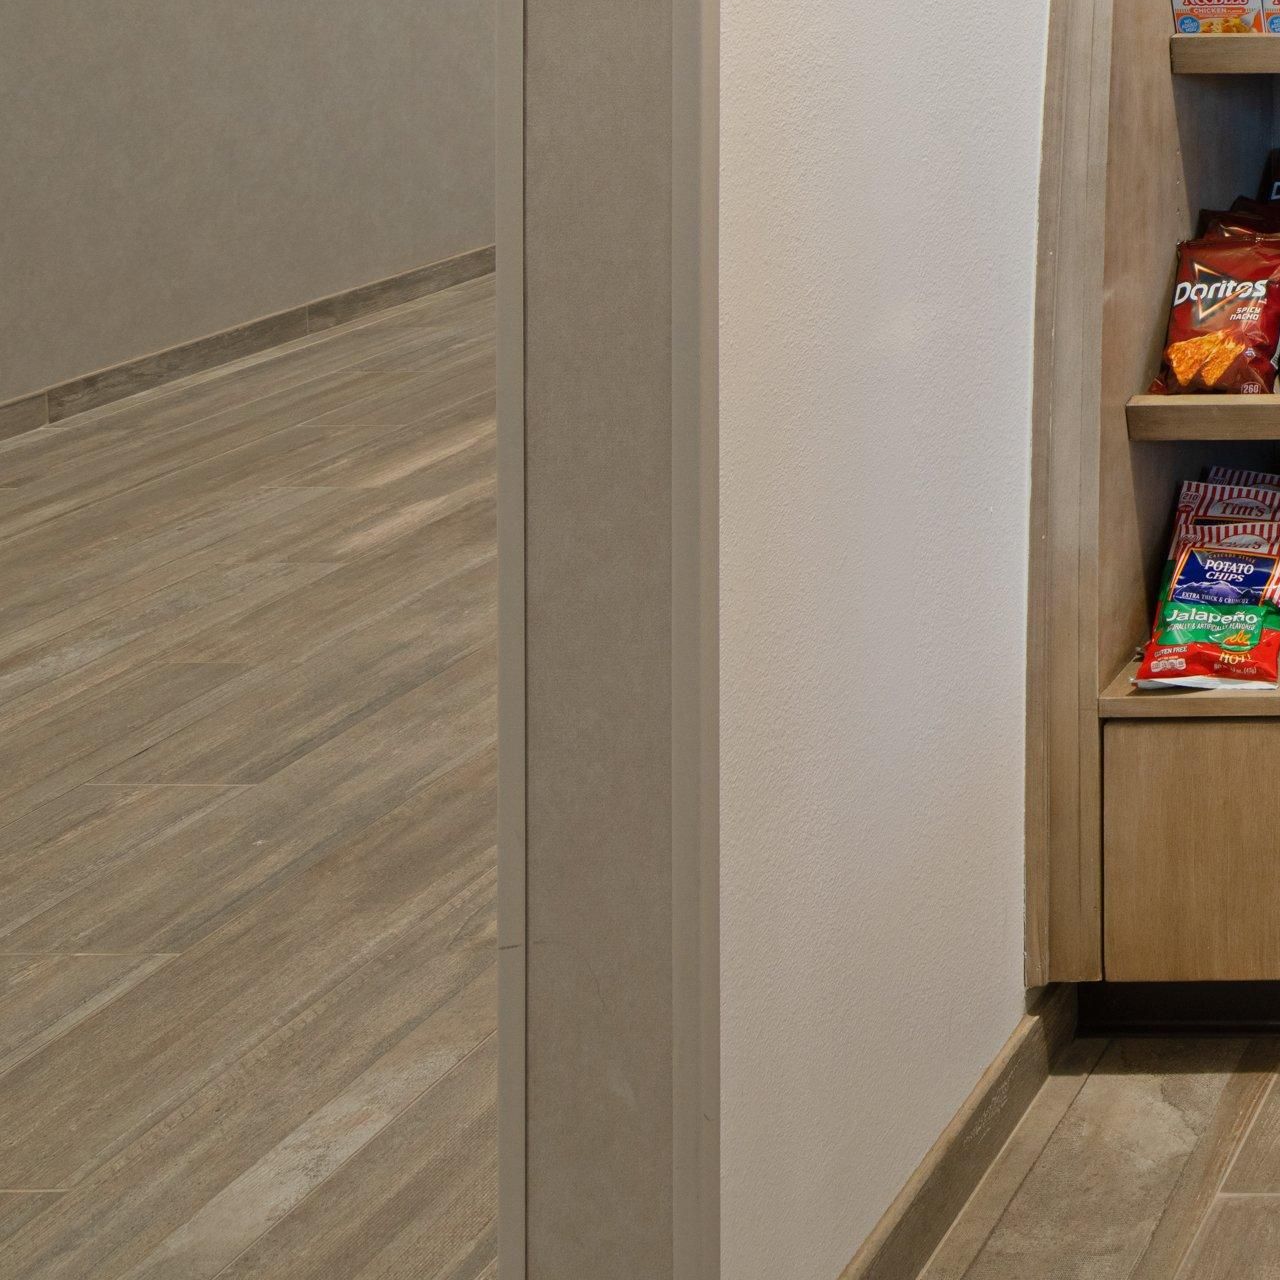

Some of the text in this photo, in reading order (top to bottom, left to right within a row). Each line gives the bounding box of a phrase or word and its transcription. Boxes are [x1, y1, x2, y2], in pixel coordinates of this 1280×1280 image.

[1174, 279, 1268, 306] Doritos
[1229, 312, 1259, 321] NACHO
[1236, 306, 1261, 314] SPICY
[1221, 500, 1266, 518] Tim's
[1204, 559, 1255, 575] POTATO
[1205, 571, 1245, 582] CHIPS
[1181, 592, 1217, 602] EXTRA THICK
[1166, 607, 1259, 624] Jalapeño
